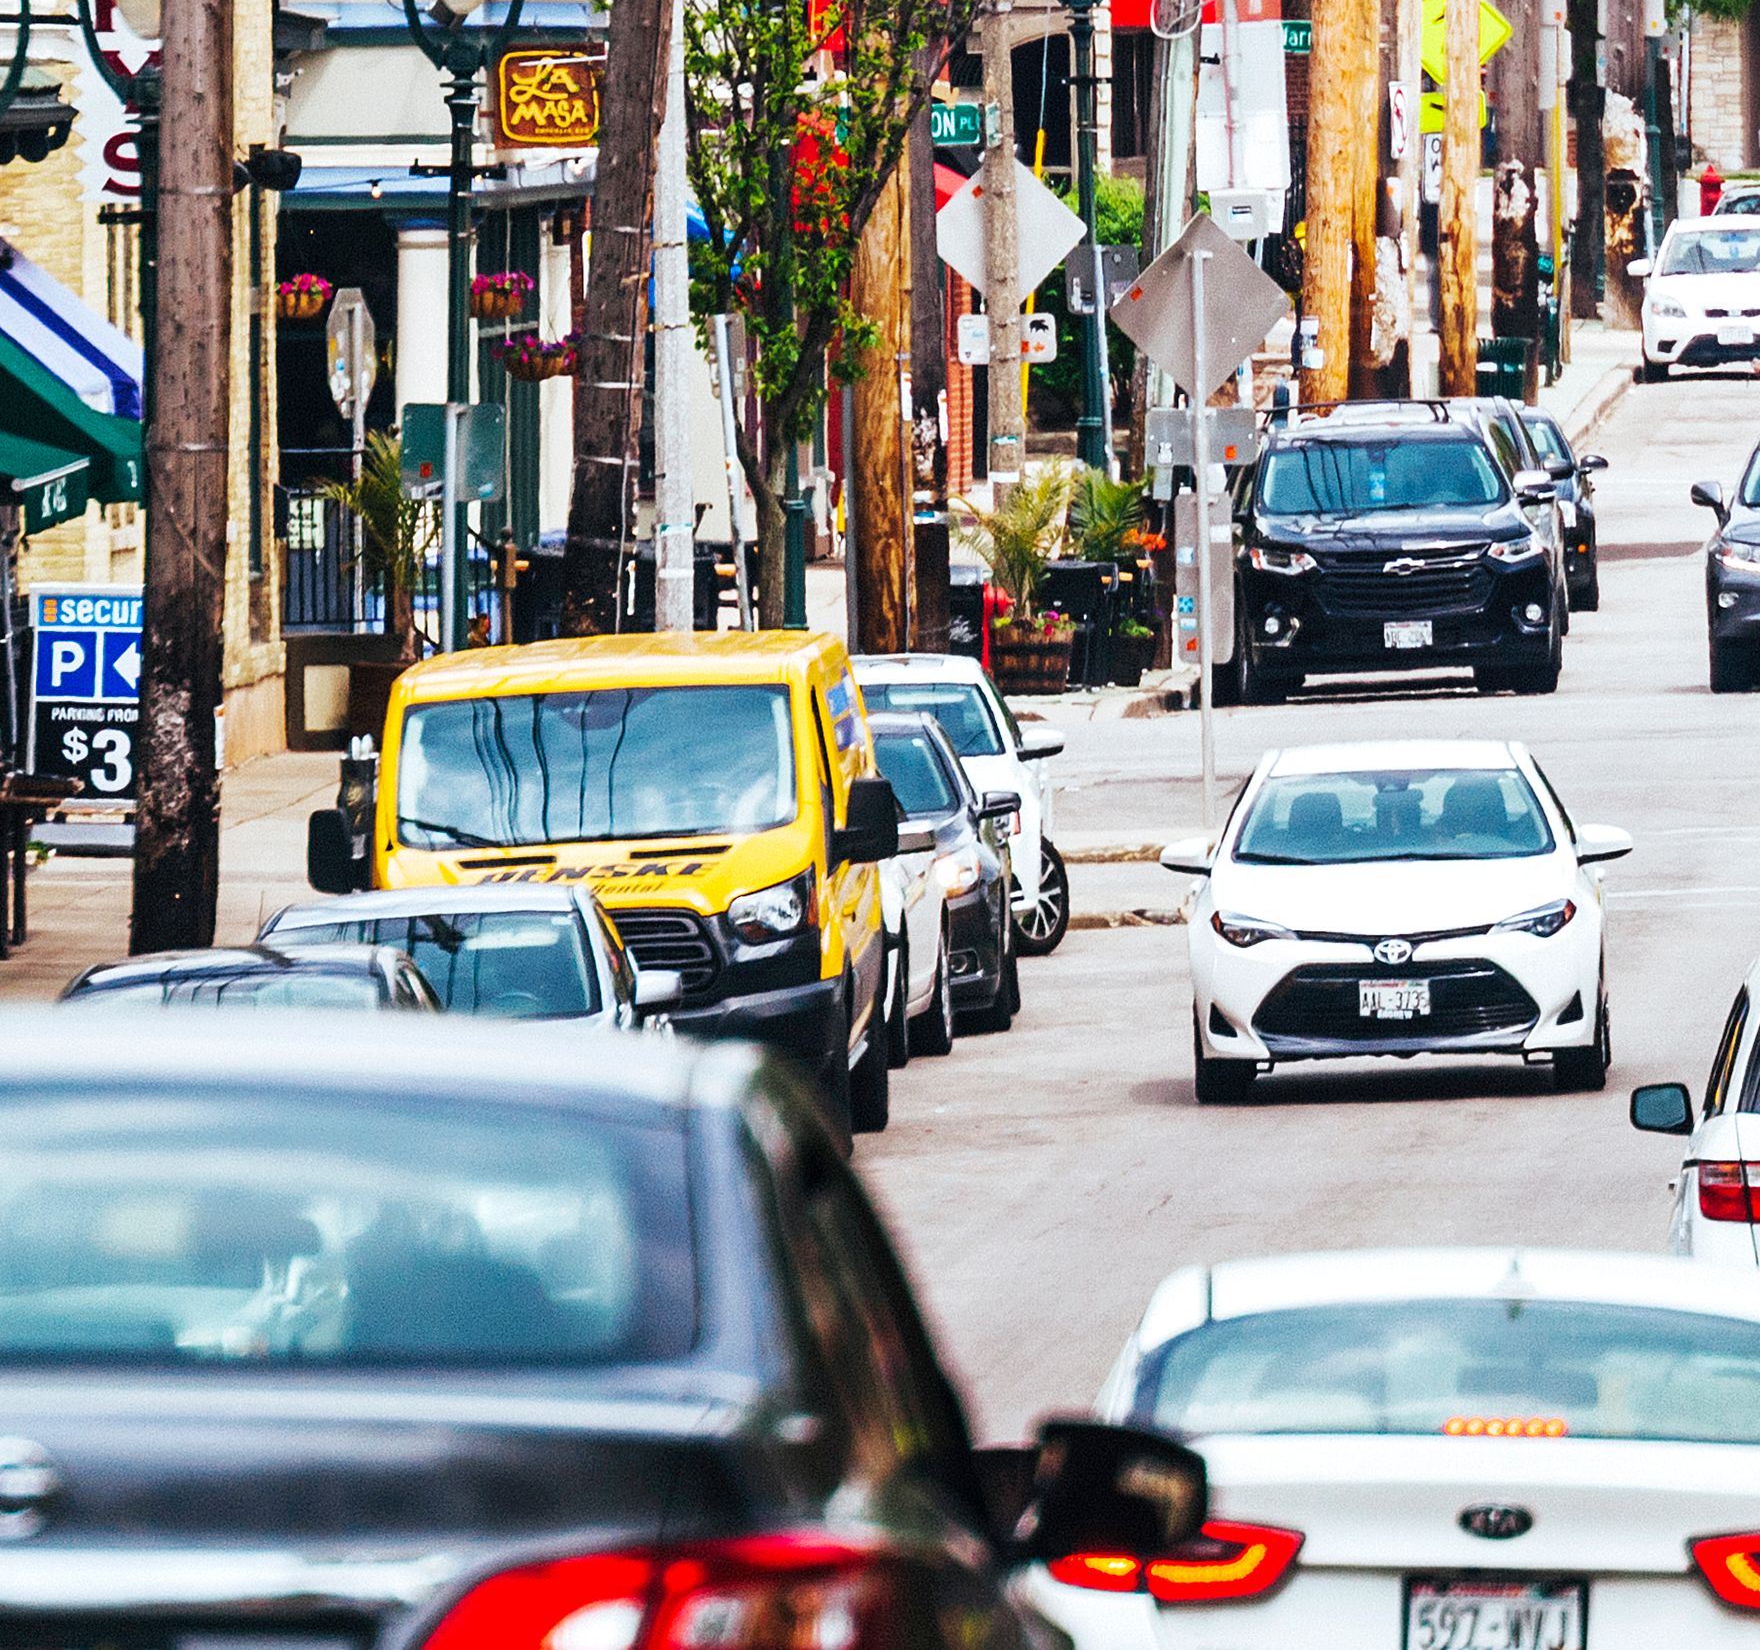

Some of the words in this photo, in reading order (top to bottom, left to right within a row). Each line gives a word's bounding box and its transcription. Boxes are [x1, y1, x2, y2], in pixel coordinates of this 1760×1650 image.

[510, 99, 589, 128] MASA
[959, 116, 976, 131] PL
[60, 598, 143, 625] secur
[51, 640, 86, 688] P
[51, 707, 105, 722] PARKING
